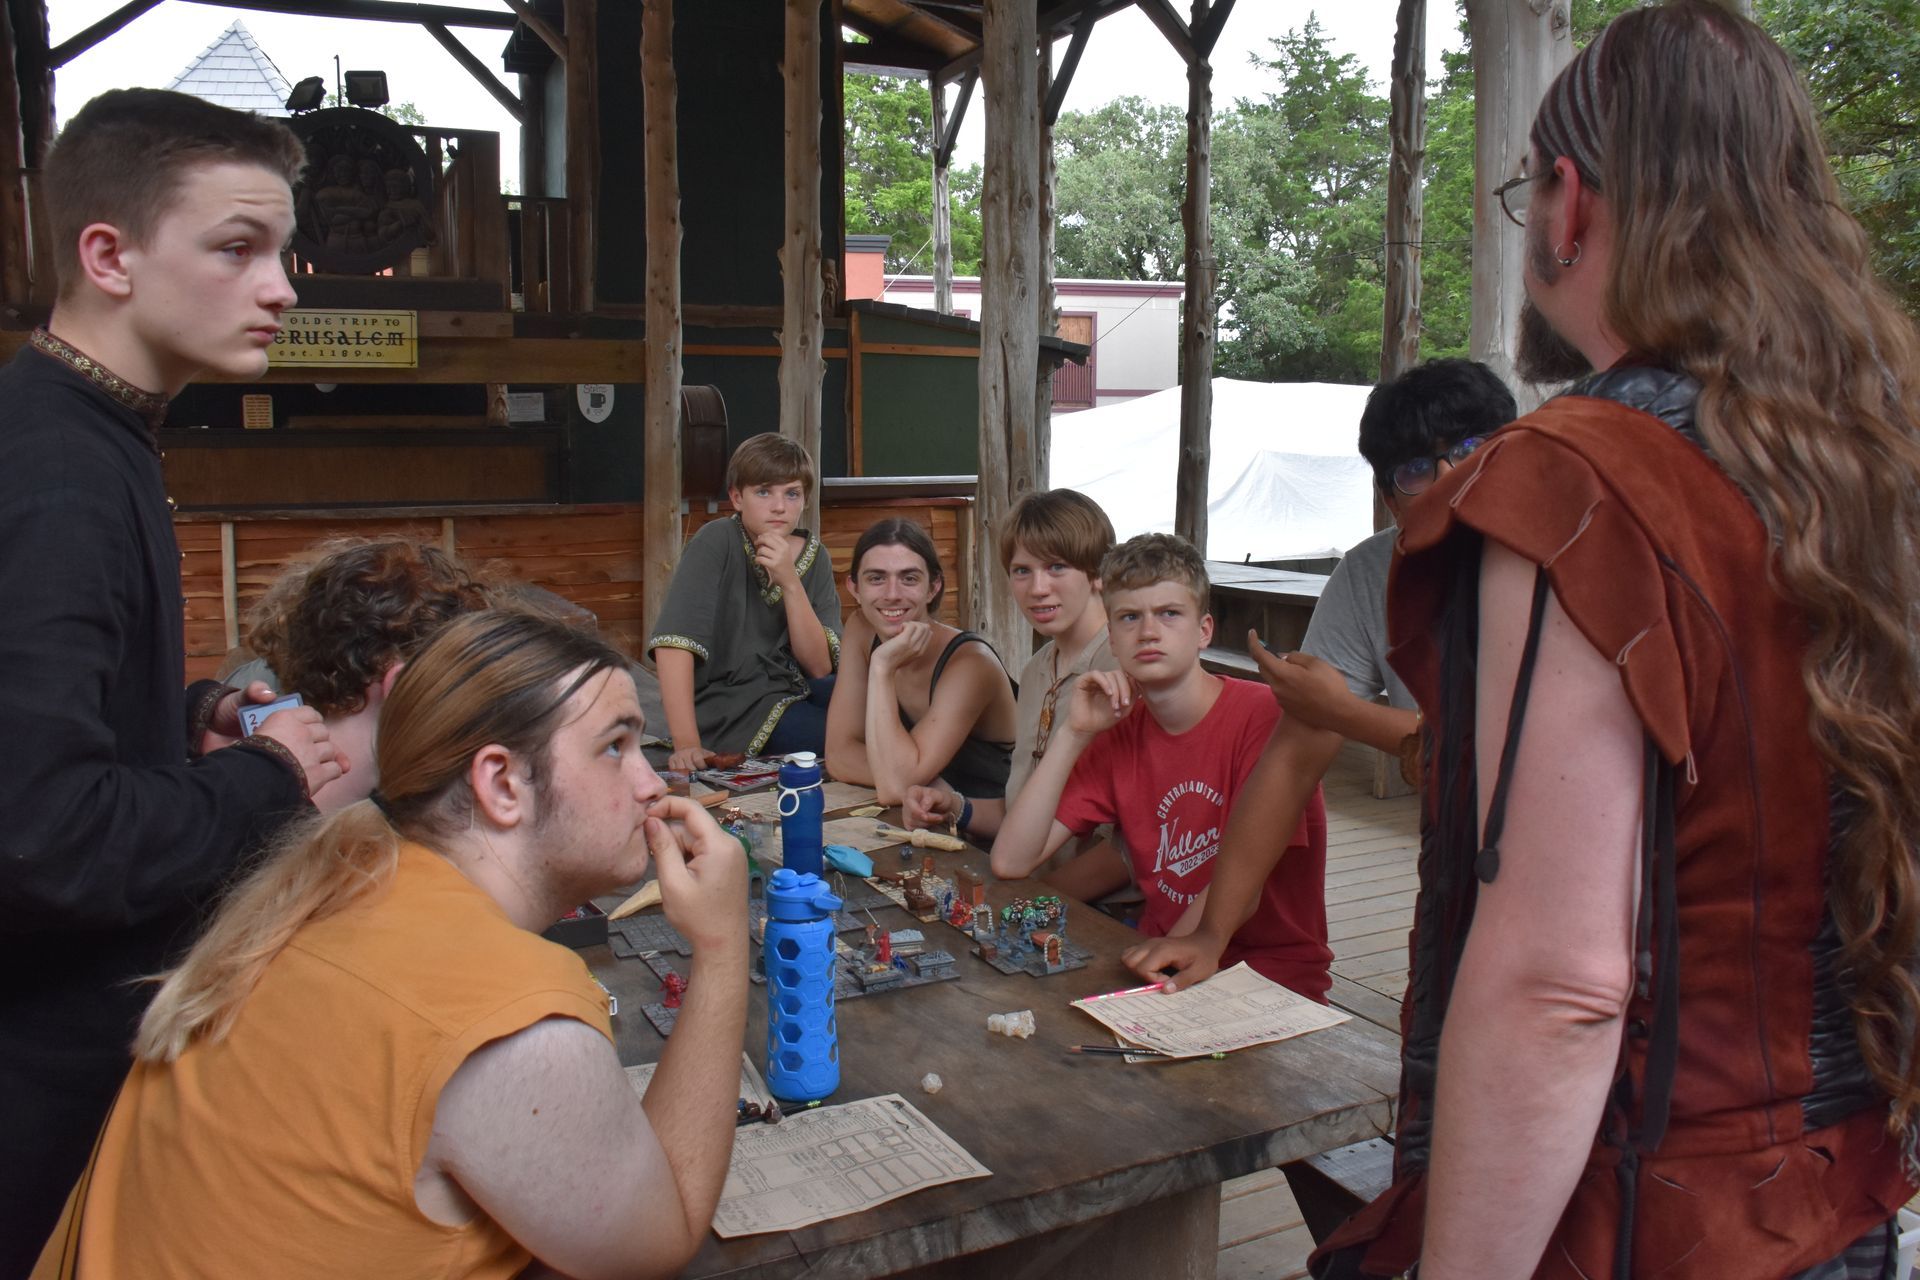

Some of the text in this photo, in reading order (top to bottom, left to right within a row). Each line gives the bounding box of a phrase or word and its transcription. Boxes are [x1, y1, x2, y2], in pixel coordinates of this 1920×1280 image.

[290, 317, 400, 327] OLDE TRIP TO
[274, 330, 406, 346] ERUSALEM
[319, 350, 361, 358] 1189
[249, 714, 257, 725] 2
[1156, 879, 1184, 905] OCKEY
